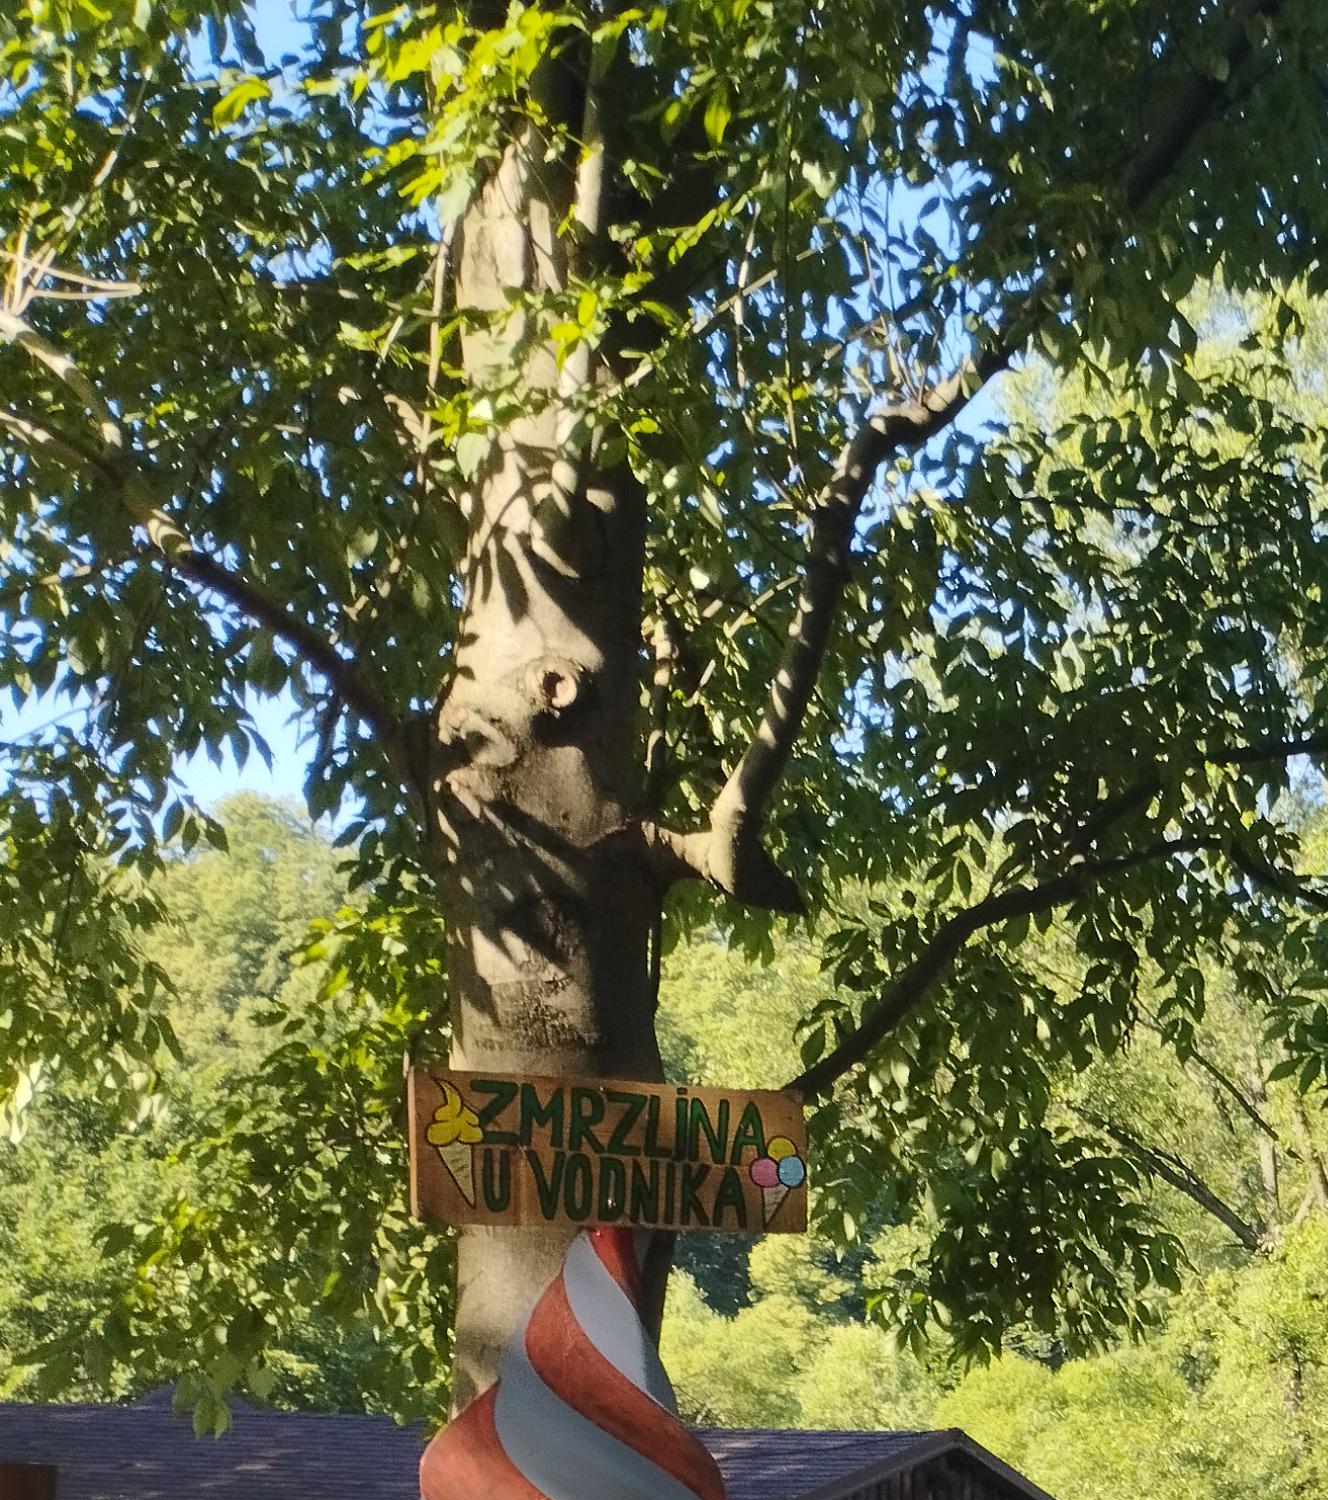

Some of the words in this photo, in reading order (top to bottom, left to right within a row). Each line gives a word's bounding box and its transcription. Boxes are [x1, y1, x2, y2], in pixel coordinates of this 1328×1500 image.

[469, 1078, 767, 1166] ZMRZLINA
[482, 1148, 511, 1213] U
[528, 1150, 749, 1230] VODNIKA
